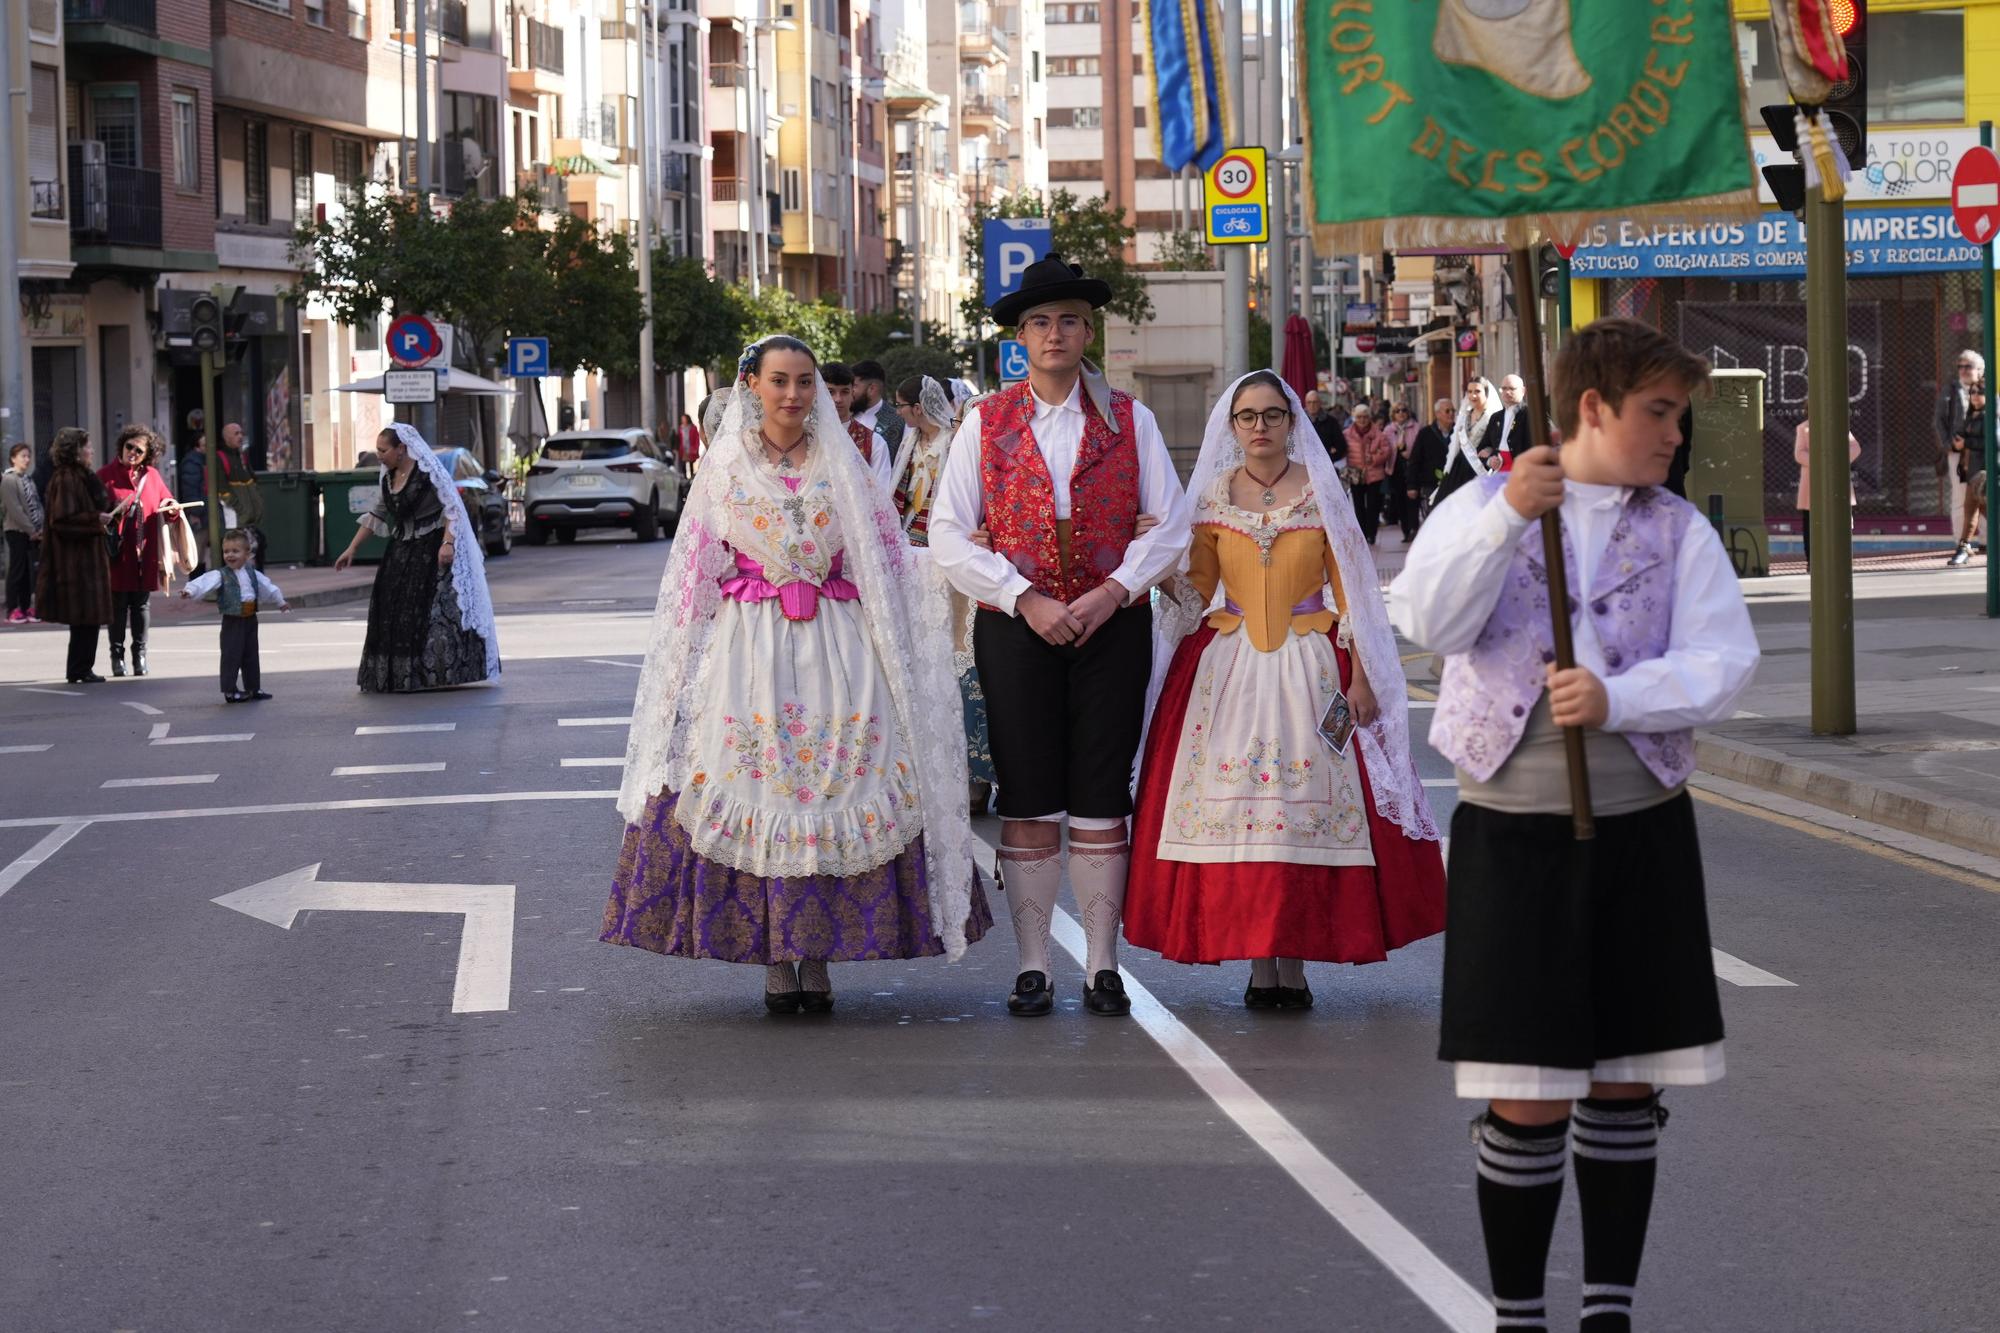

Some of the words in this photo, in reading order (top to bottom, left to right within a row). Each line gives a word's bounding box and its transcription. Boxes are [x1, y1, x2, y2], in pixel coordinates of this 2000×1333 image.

[1410, 114, 1551, 193] DELS
[1559, 0, 1696, 183] CORDER
[1867, 143, 1878, 158] A
[1888, 140, 1949, 158] TODO
[1223, 169, 1248, 184] 30
[1866, 159, 1952, 185] COLOR
[1215, 206, 1258, 215] CICLOCALLE
[1758, 219, 1787, 245] DE
[1844, 214, 1963, 242] IMPRESIO
[1000, 242, 1036, 288] P
[1654, 251, 1751, 271] ORIGINALES
[1870, 248, 1881, 263] Y
[1887, 246, 1984, 264] RECICLADO
[404, 333, 419, 351] P
[516, 343, 541, 373] P
